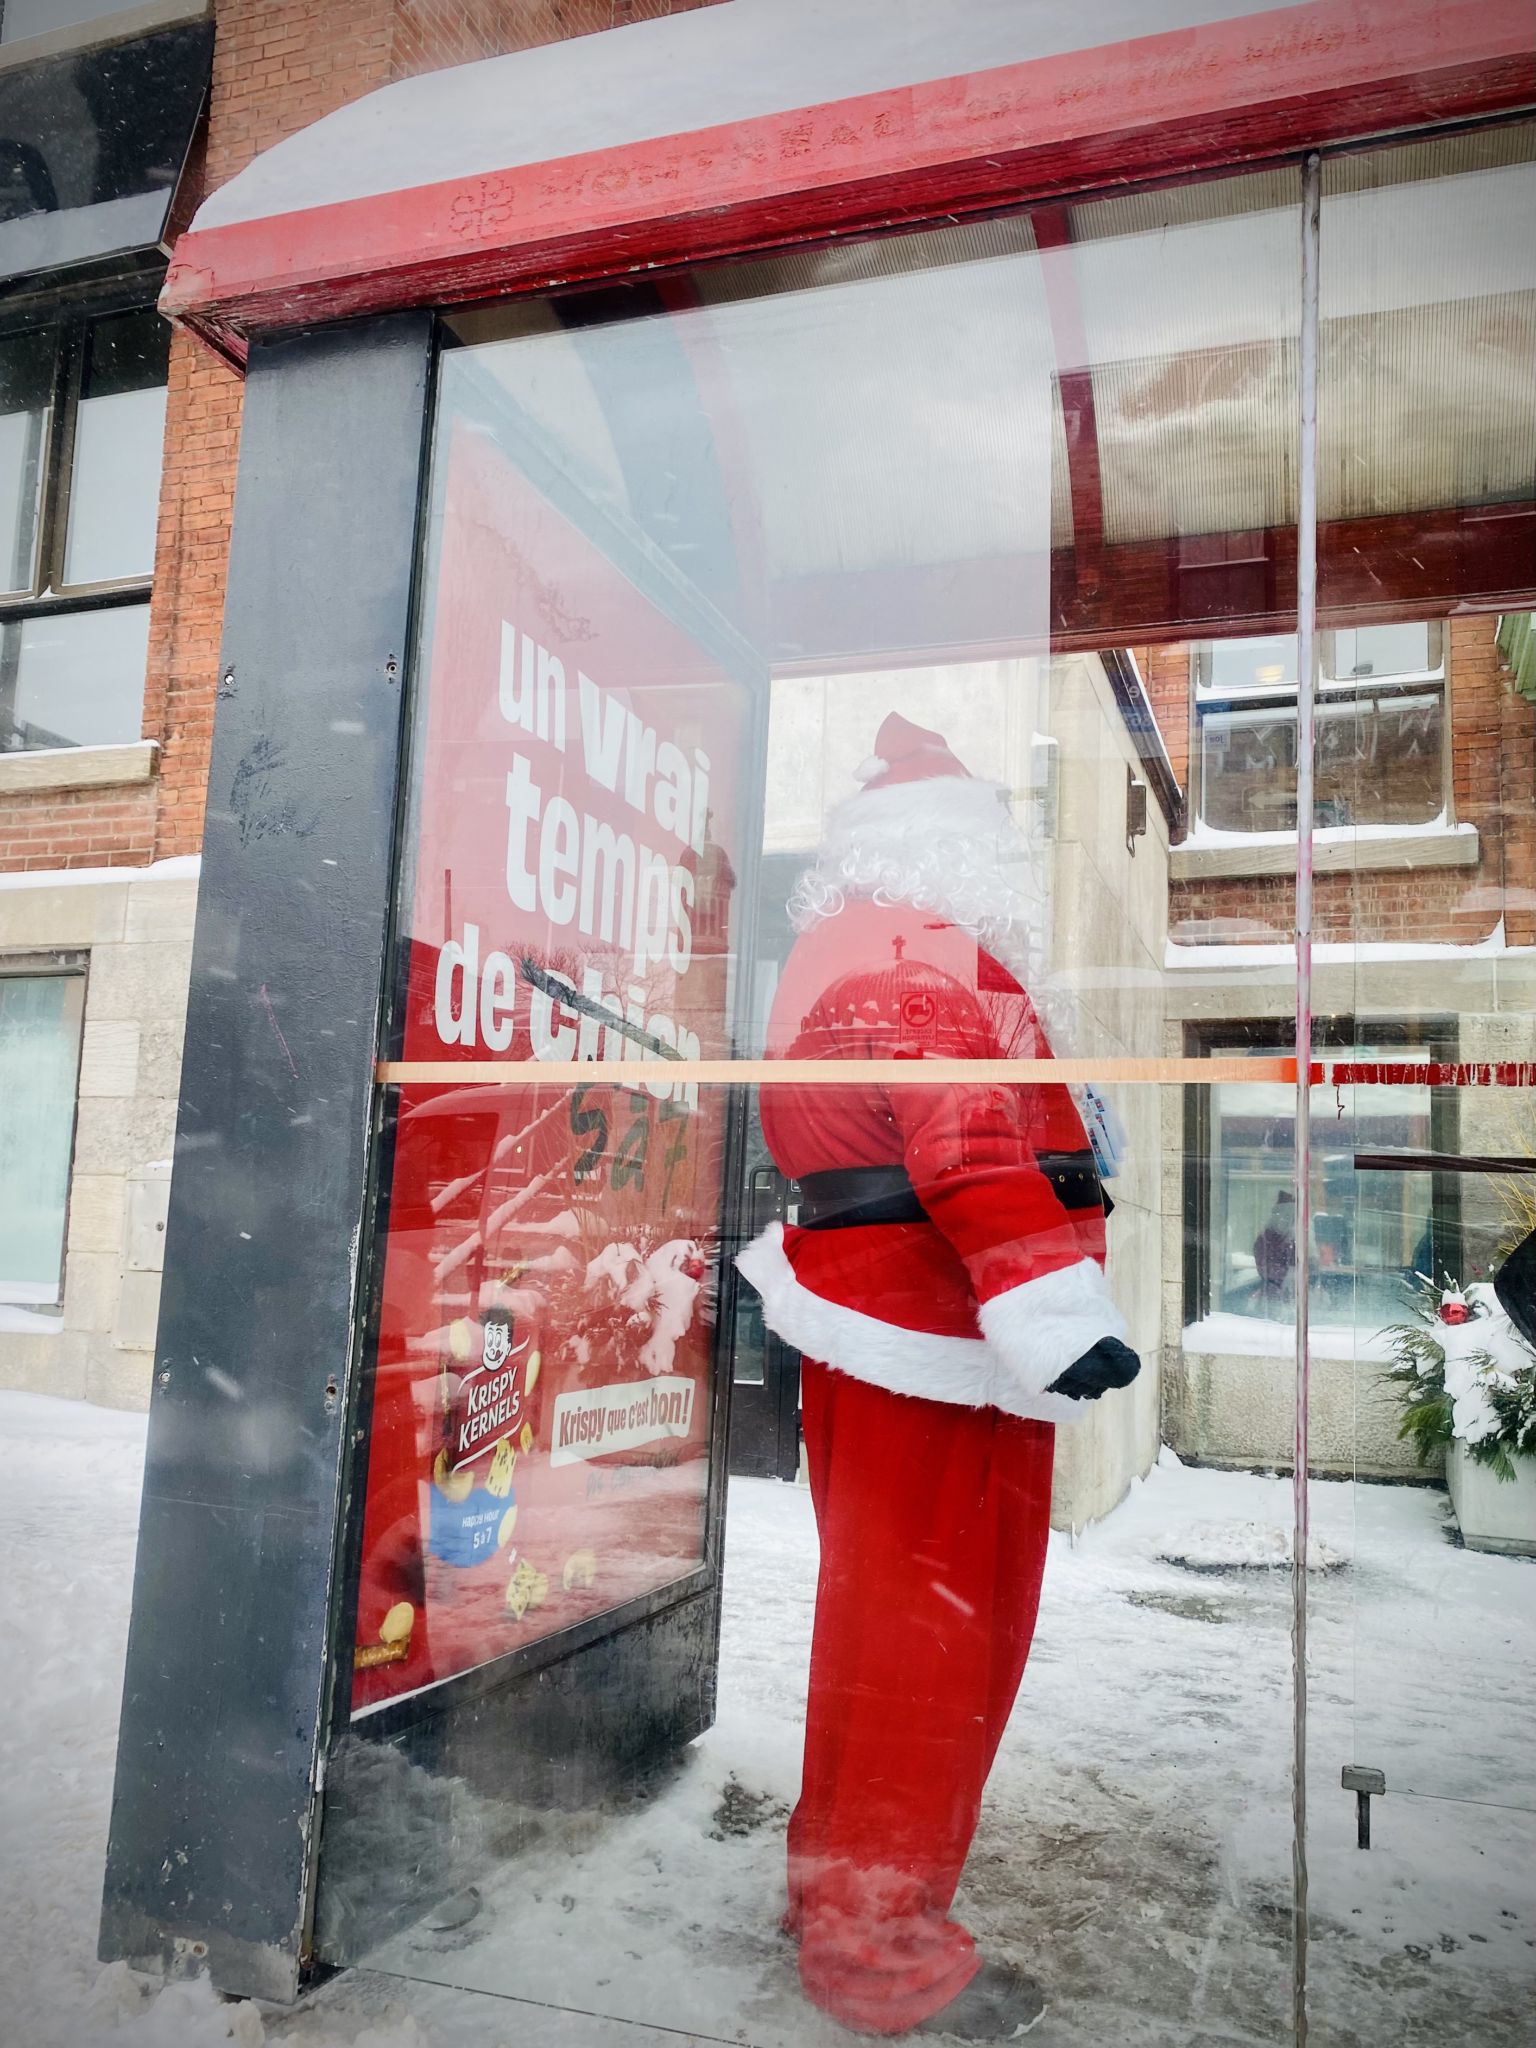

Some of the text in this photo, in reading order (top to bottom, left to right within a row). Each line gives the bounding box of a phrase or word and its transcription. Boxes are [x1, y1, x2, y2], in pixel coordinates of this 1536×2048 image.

[500, 619, 711, 859] un vrai
[505, 751, 695, 978] temps
[435, 923, 516, 1052] de
[659, 1101, 690, 1217] 7
[458, 1390, 521, 1452] KERNELS
[467, 1366, 518, 1417] KRISPY
[558, 1387, 691, 1448] Krispy que c'est bon!
[473, 1531, 481, 1550] 5
[486, 1526, 493, 1544] 7
